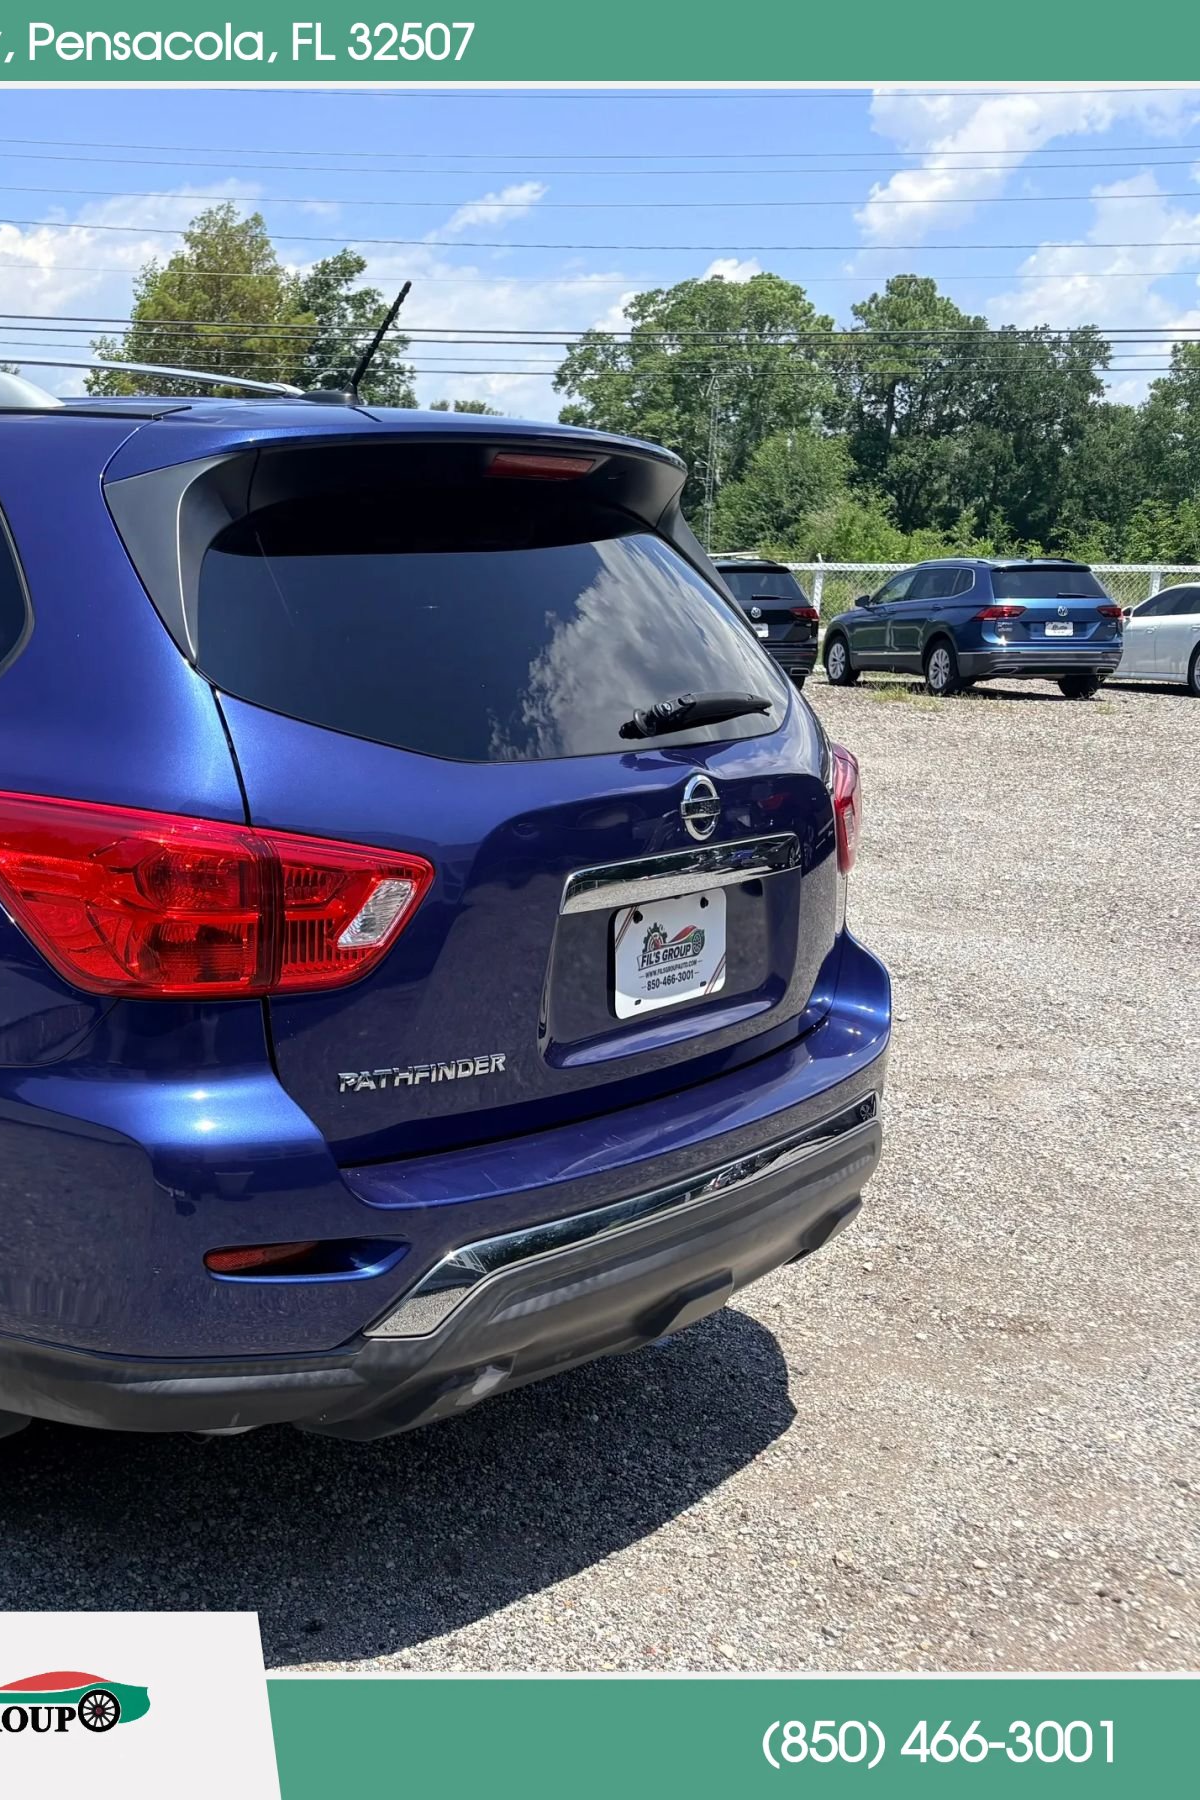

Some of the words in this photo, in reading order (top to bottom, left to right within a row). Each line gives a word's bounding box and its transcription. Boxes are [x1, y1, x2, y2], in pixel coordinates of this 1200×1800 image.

[641, 950, 660, 968] FIL'S
[662, 943, 692, 961] GROUP
[647, 969, 694, 991] 850-466-3001
[337, 1053, 507, 1093] PATHFINDER
